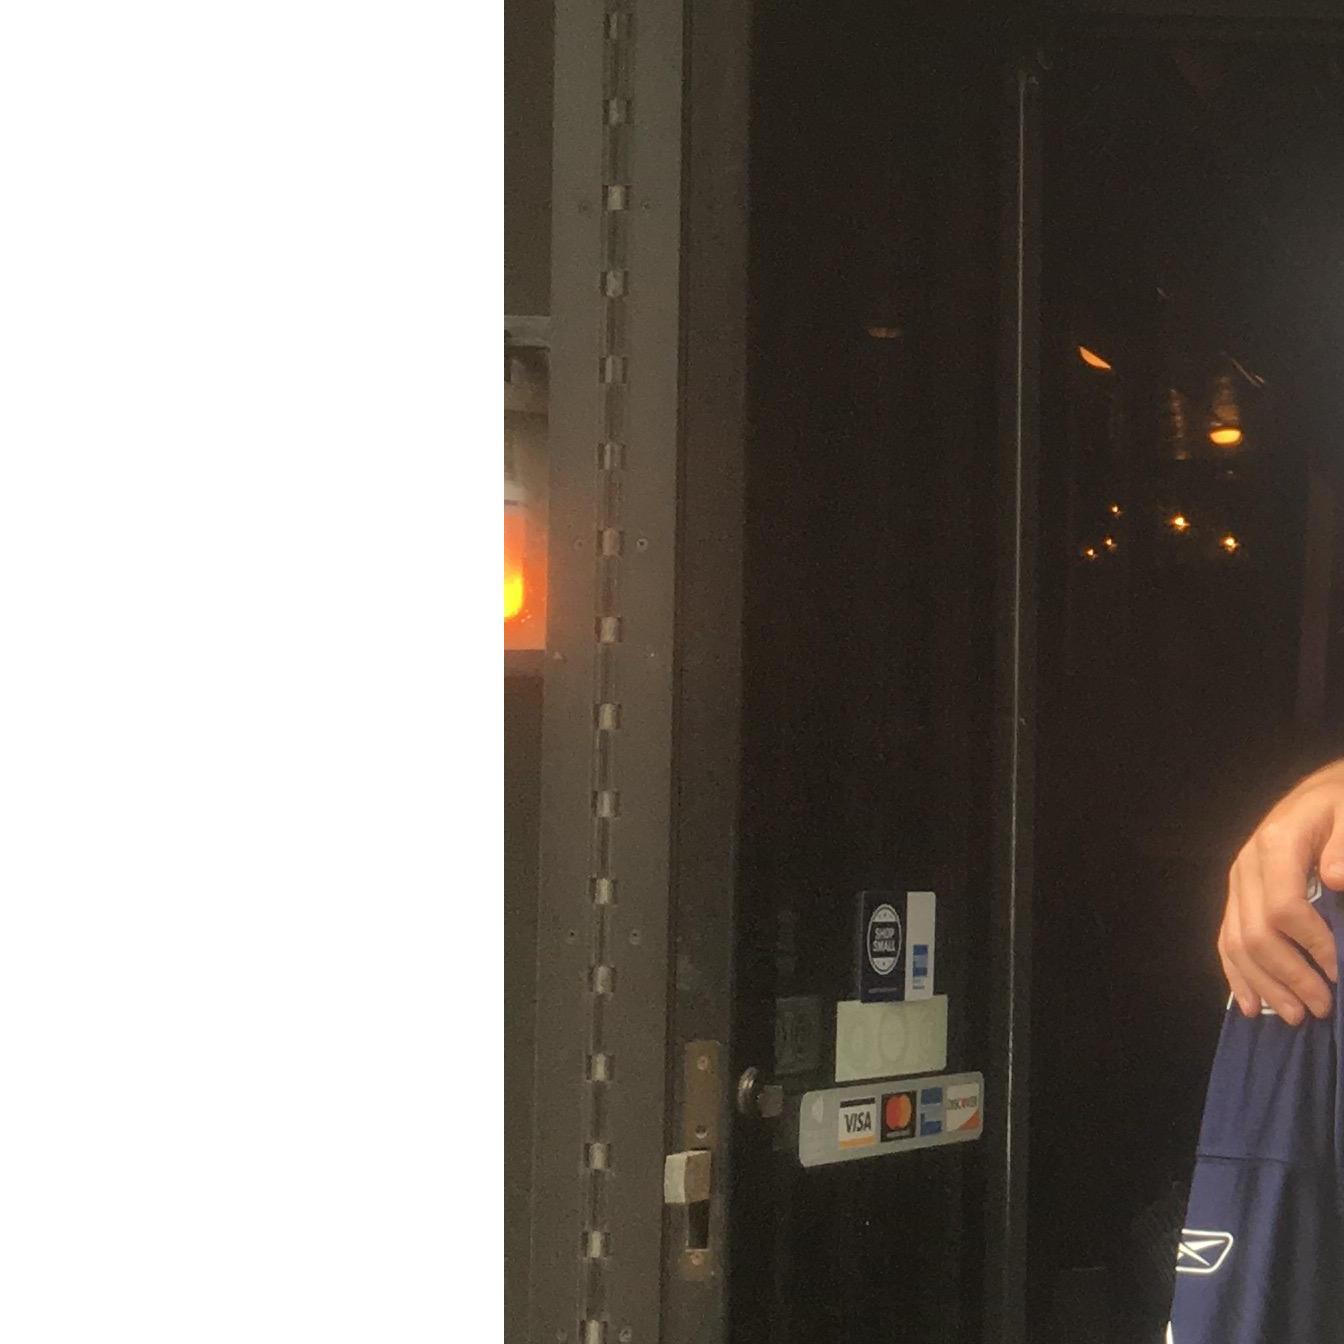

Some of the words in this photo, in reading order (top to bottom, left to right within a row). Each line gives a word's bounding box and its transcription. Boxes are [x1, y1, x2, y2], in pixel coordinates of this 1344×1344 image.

[874, 926, 896, 940] SHOP
[872, 939, 896, 953] SMALL
[844, 1112, 872, 1133] VISA
